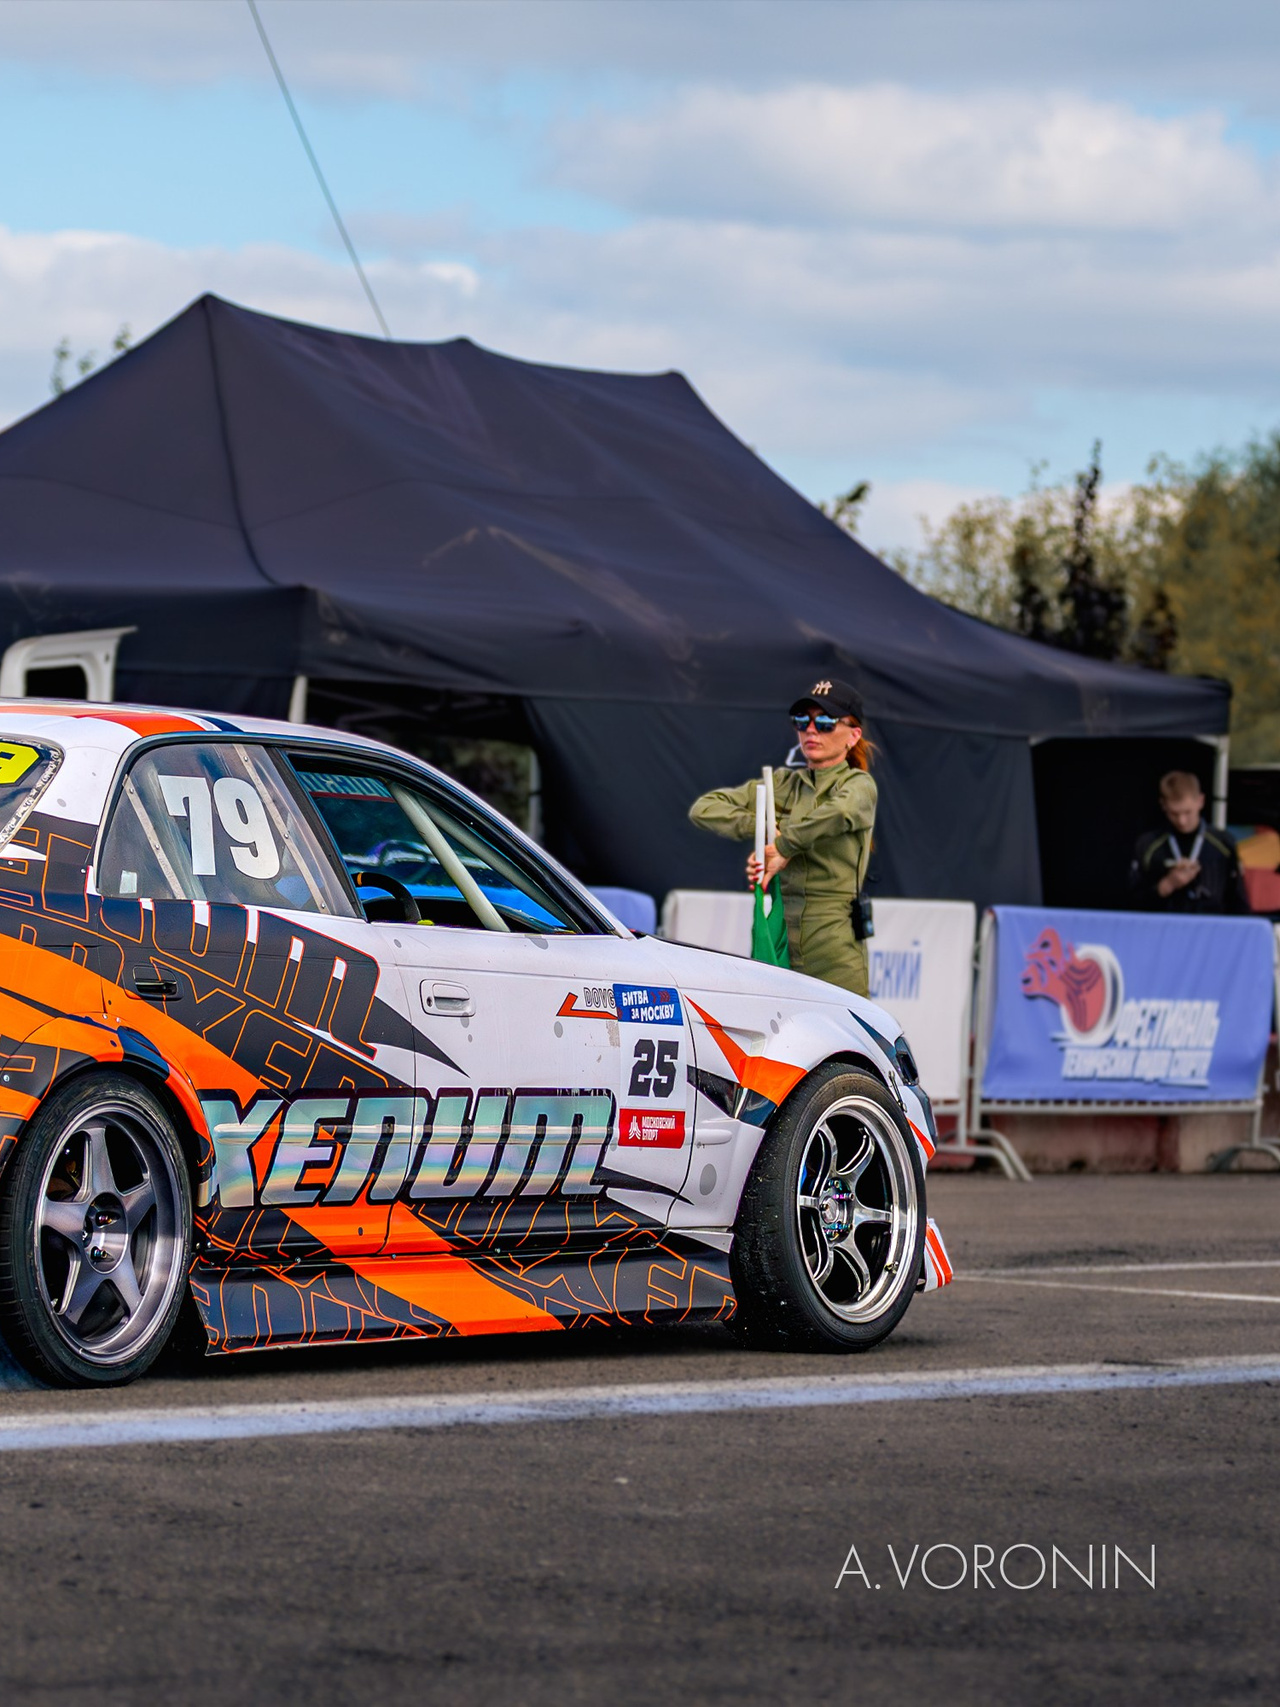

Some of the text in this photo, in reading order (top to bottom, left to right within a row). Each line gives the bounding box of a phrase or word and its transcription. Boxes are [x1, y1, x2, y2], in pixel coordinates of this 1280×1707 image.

[157, 774, 281, 880] 79
[621, 989, 649, 1007] БИТВА
[630, 1004, 675, 1022] ЗА МОСКВУ
[1116, 998, 1221, 1049] ФЕСТИВАЛЬ
[627, 1038, 680, 1098] 25
[199, 1089, 616, 1209] XENUM
[641, 1128, 659, 1141] СПОРТ
